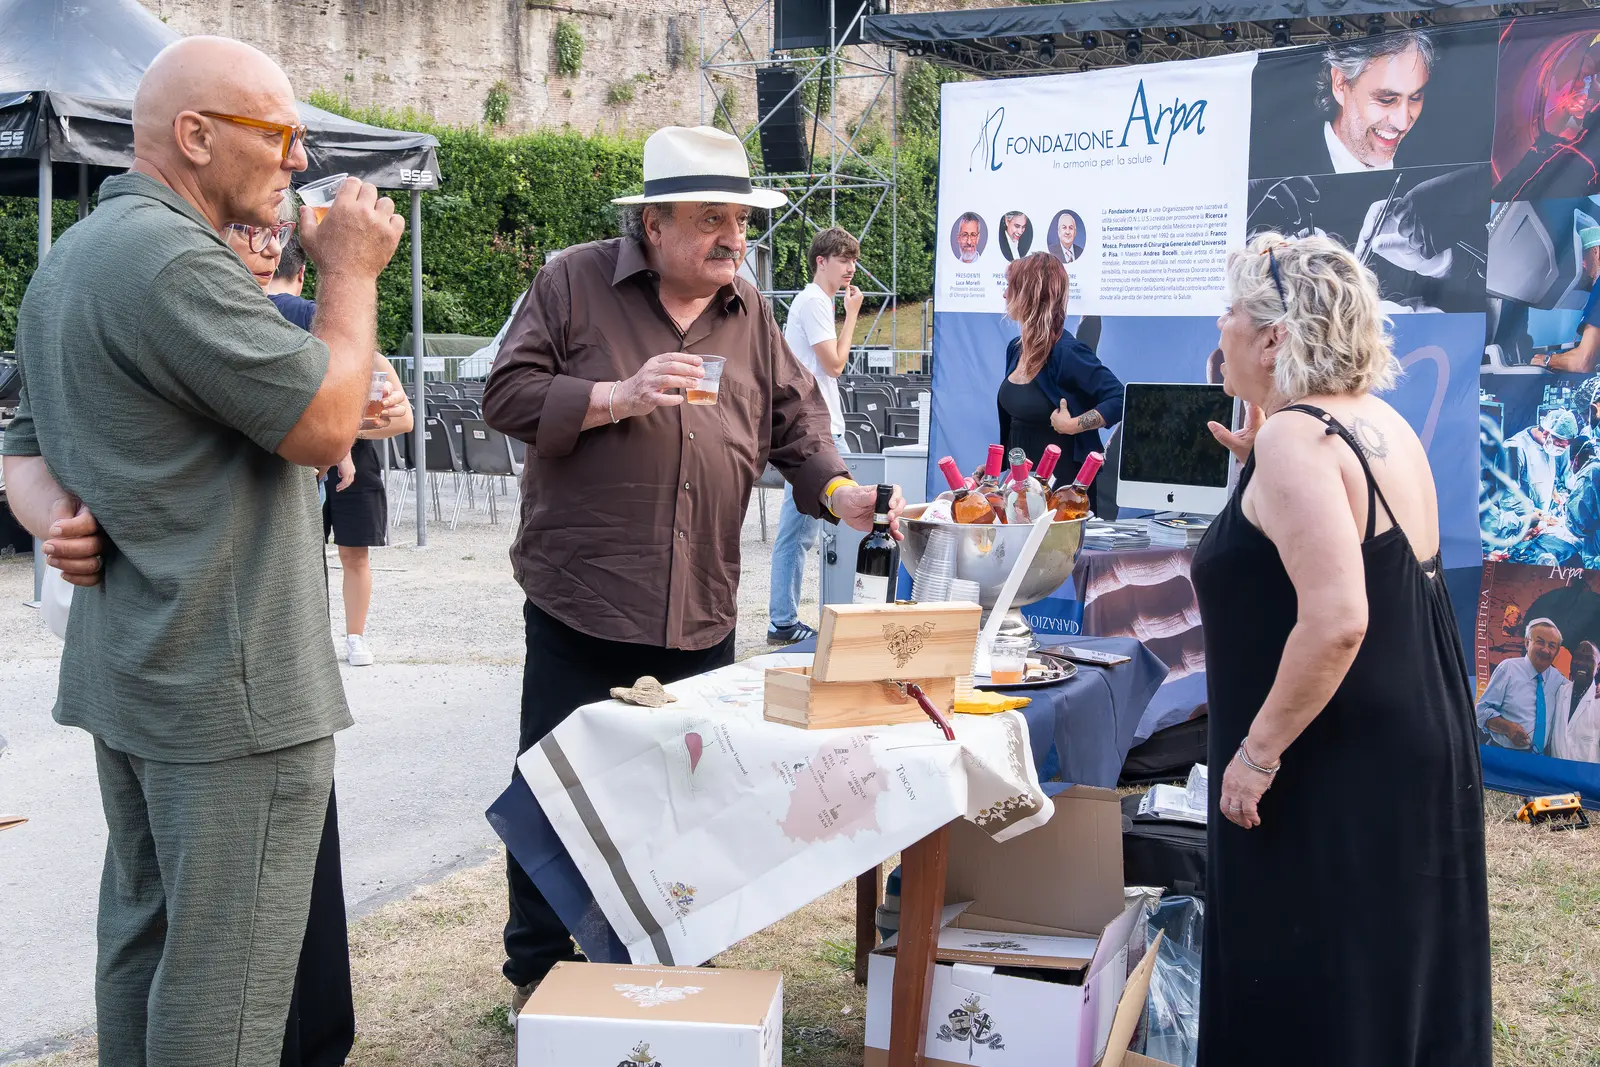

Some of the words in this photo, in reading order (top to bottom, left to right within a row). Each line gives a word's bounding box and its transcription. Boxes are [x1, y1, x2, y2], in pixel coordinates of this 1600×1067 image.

[1006, 130, 1114, 155] FONDAZIONE
[1116, 78, 1208, 166] Arpa
[400, 169, 432, 182] BSS
[1052, 160, 1060, 170] In
[1063, 158, 1098, 169] armonia
[1100, 157, 1114, 169] per
[1116, 156, 1125, 166] la
[1128, 154, 1152, 165] salute
[1162, 204, 1194, 213] Organizzazione
[1548, 559, 1584, 586] Arpa
[1478, 588, 1489, 641] PIETRA
[1478, 645, 1486, 660] DI
[849, 770, 867, 799] FLORENCE
[896, 764, 916, 800] TUSCANY
